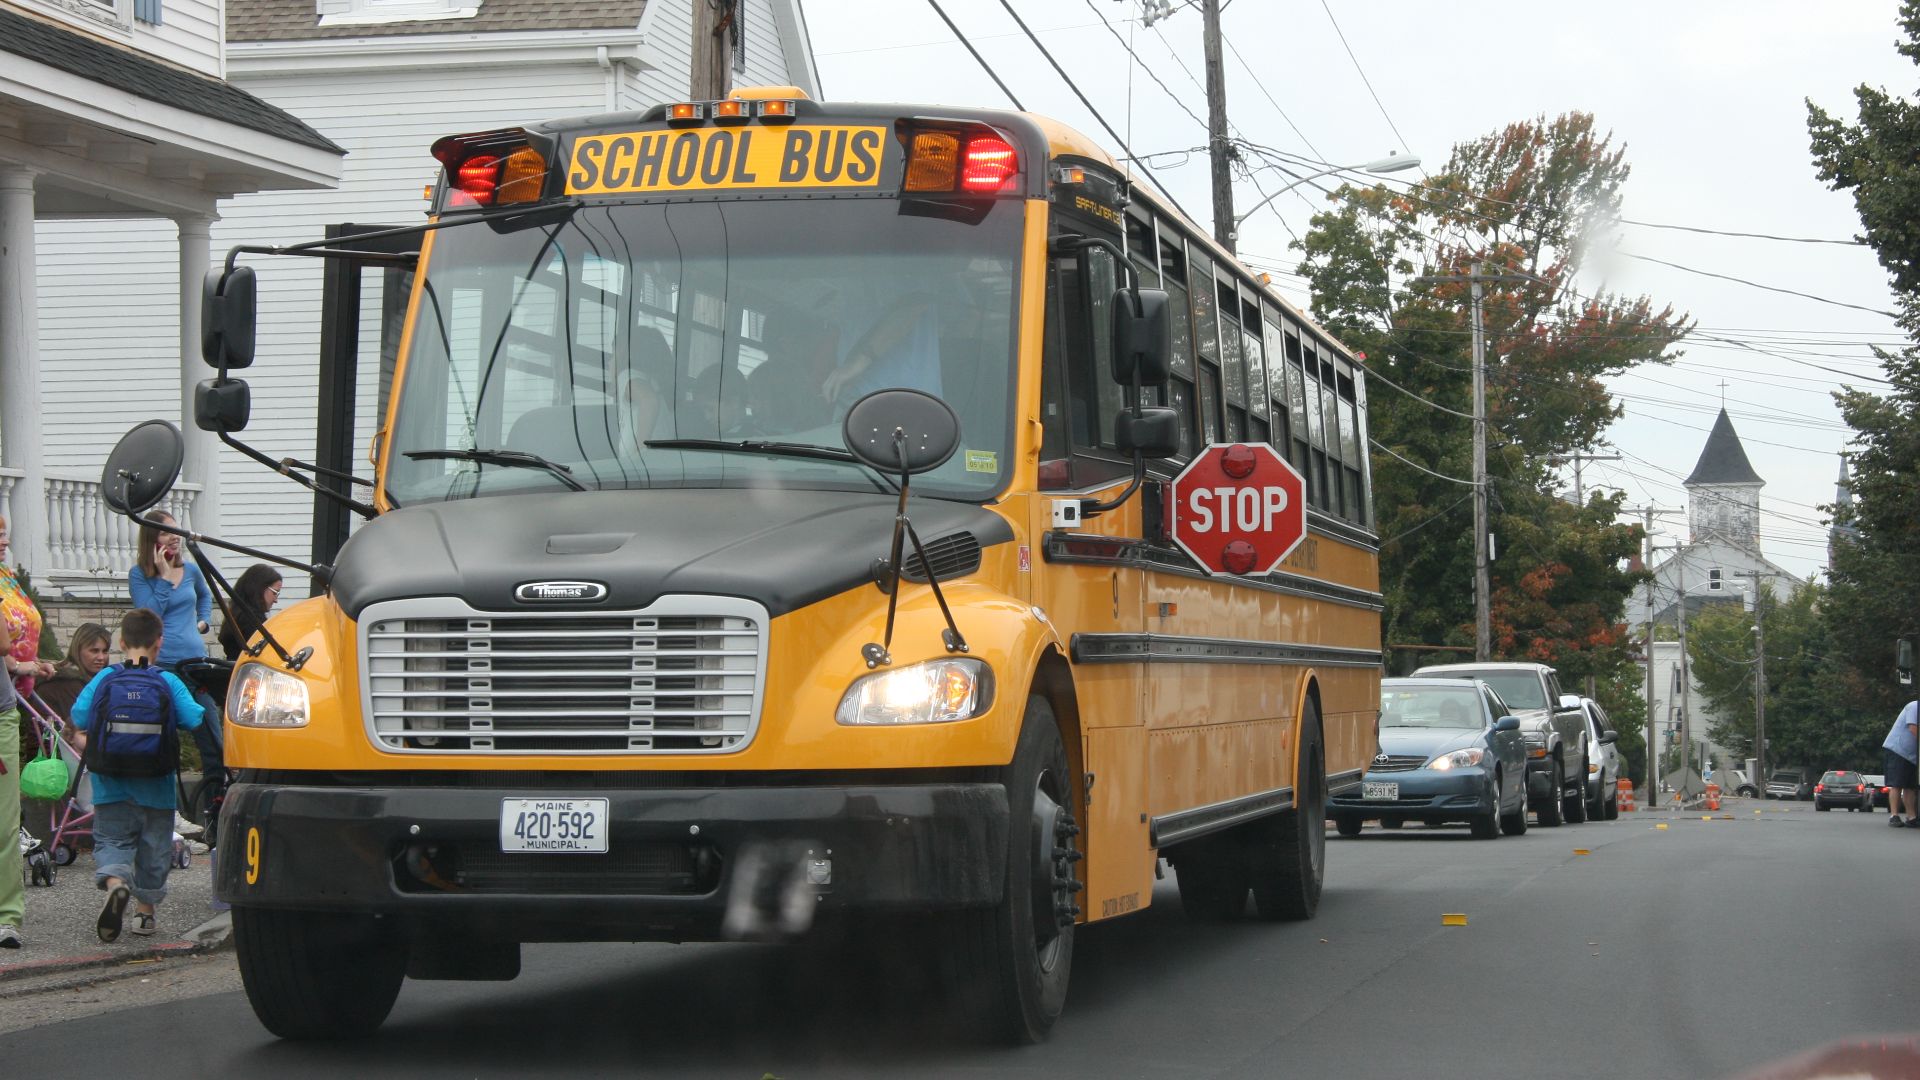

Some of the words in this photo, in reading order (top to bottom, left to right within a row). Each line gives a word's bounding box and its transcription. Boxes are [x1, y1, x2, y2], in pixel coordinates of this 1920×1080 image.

[570, 130, 756, 190] SCHOOL
[779, 130, 880, 183] BUS
[1190, 486, 1288, 533] STOP
[533, 585, 588, 598] Thomas
[1112, 571, 1119, 620] 9
[127, 692, 141, 700] BTS
[535, 802, 574, 811] MAINE
[246, 827, 260, 885] 9
[526, 840, 581, 849] MUNICIPAL
